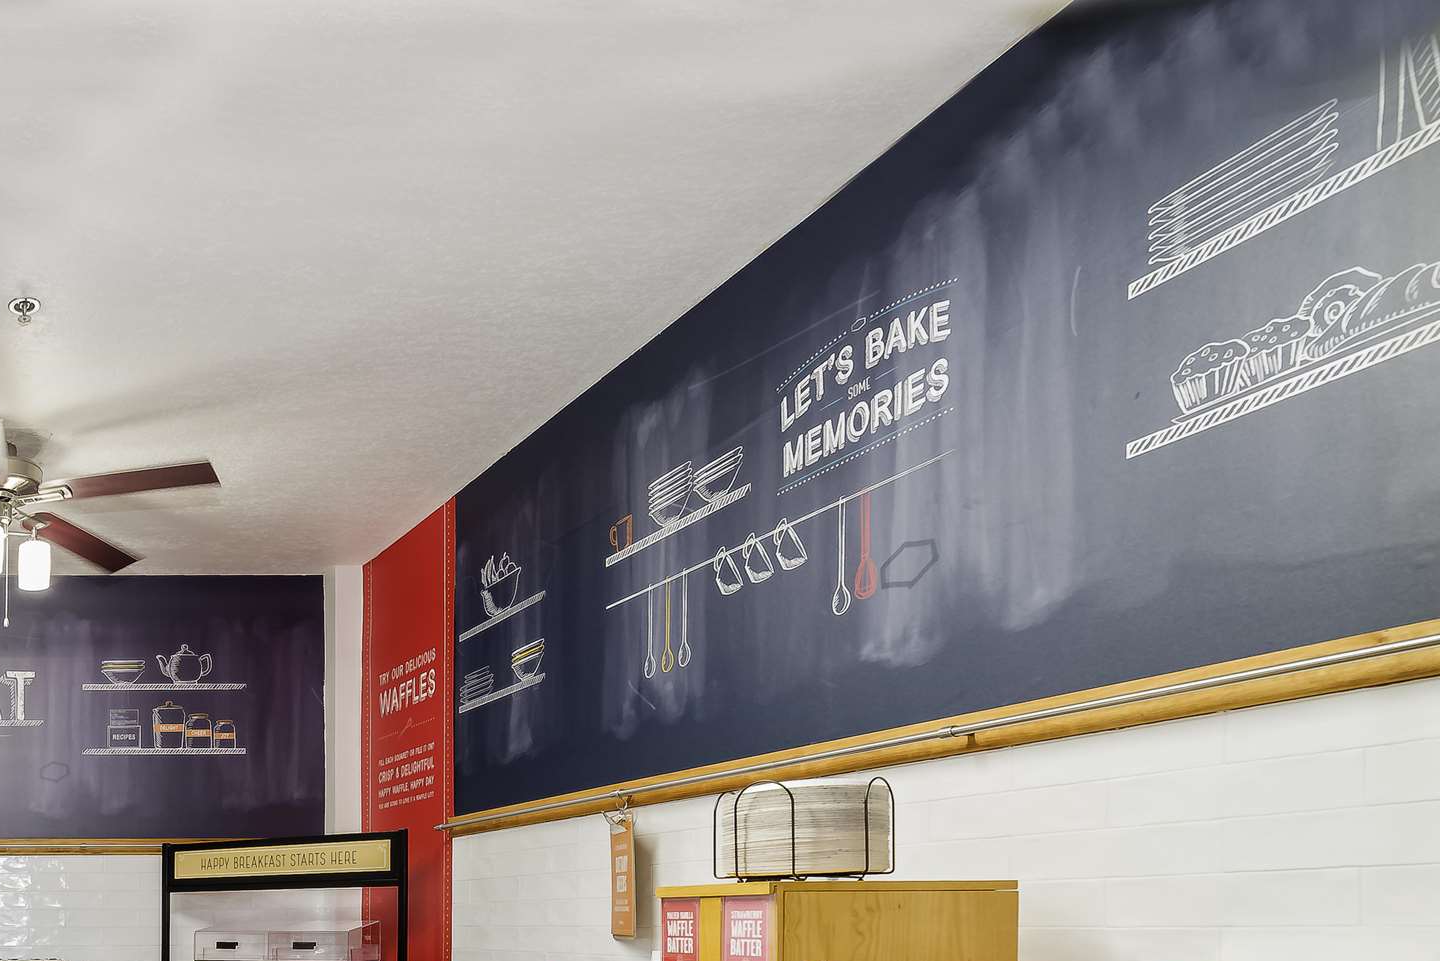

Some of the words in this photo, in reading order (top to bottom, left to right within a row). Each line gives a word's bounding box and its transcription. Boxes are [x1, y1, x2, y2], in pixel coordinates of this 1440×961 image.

[780, 345, 854, 432] LET'S
[865, 299, 952, 369] BAKE
[847, 376, 871, 400] SOME
[782, 357, 950, 478] MEMORIES
[379, 672, 390, 686] TRY
[391, 664, 404, 680] OUR
[405, 647, 436, 675] DELICIOUS
[379, 668, 436, 718] WAFFLES
[378, 768, 394, 784] CRISP
[400, 755, 435, 778] DELIGHTFUL
[378, 786, 391, 798] HAPPY
[410, 777, 425, 790] HAPPY
[425, 775, 435, 786] DAY
[200, 857, 230, 871] HAPPY
[233, 854, 287, 870] BREAKFAST
[290, 852, 326, 867] STARTS
[330, 850, 357, 865] HERE
[666, 920, 694, 937] WAFFLE
[730, 920, 763, 938] WAFFLE
[666, 937, 694, 954] BATTER
[729, 938, 763, 957] BATTER
